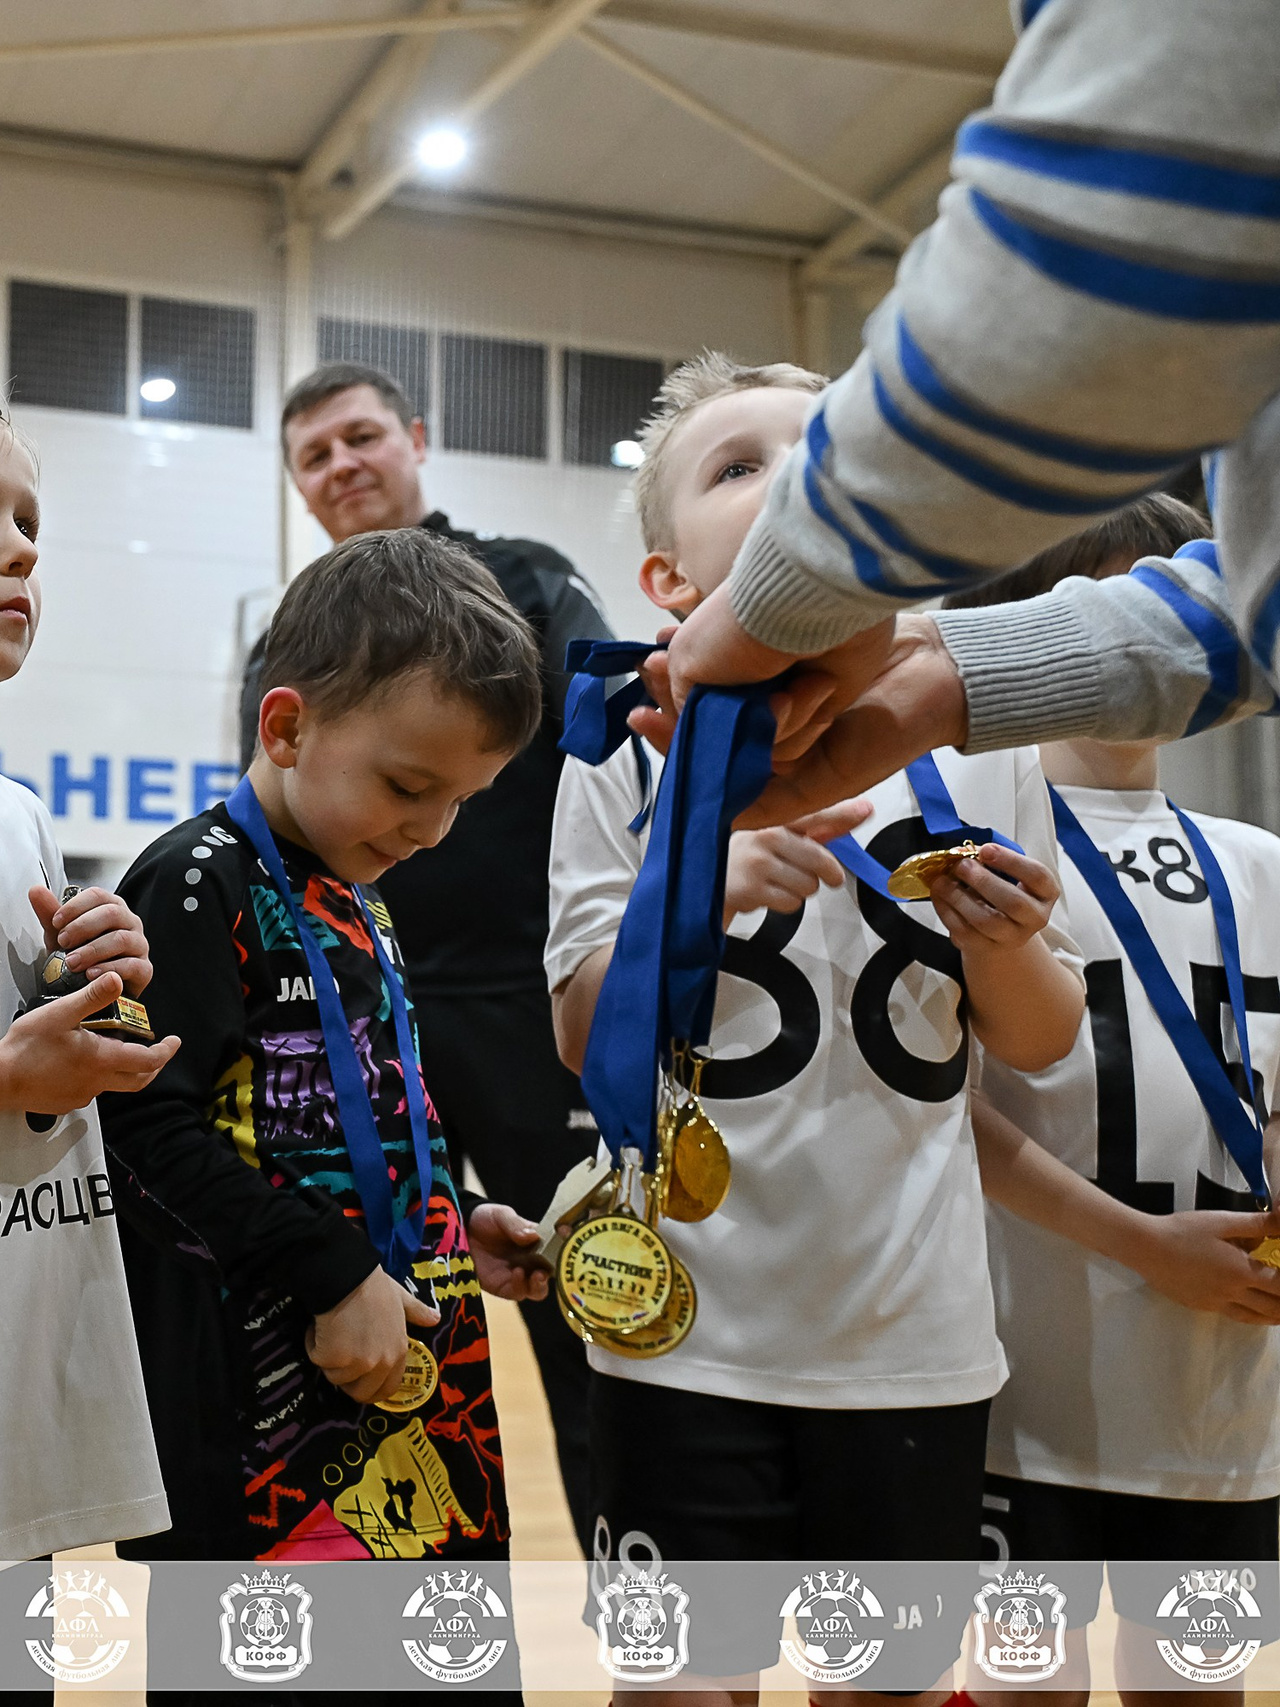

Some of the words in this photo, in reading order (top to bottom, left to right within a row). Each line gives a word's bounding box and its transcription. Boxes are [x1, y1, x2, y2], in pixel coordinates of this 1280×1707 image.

[276, 975, 341, 1003] JA
[582, 1251, 654, 1281] УЧАСТНИК
[892, 1593, 943, 1631] JA
